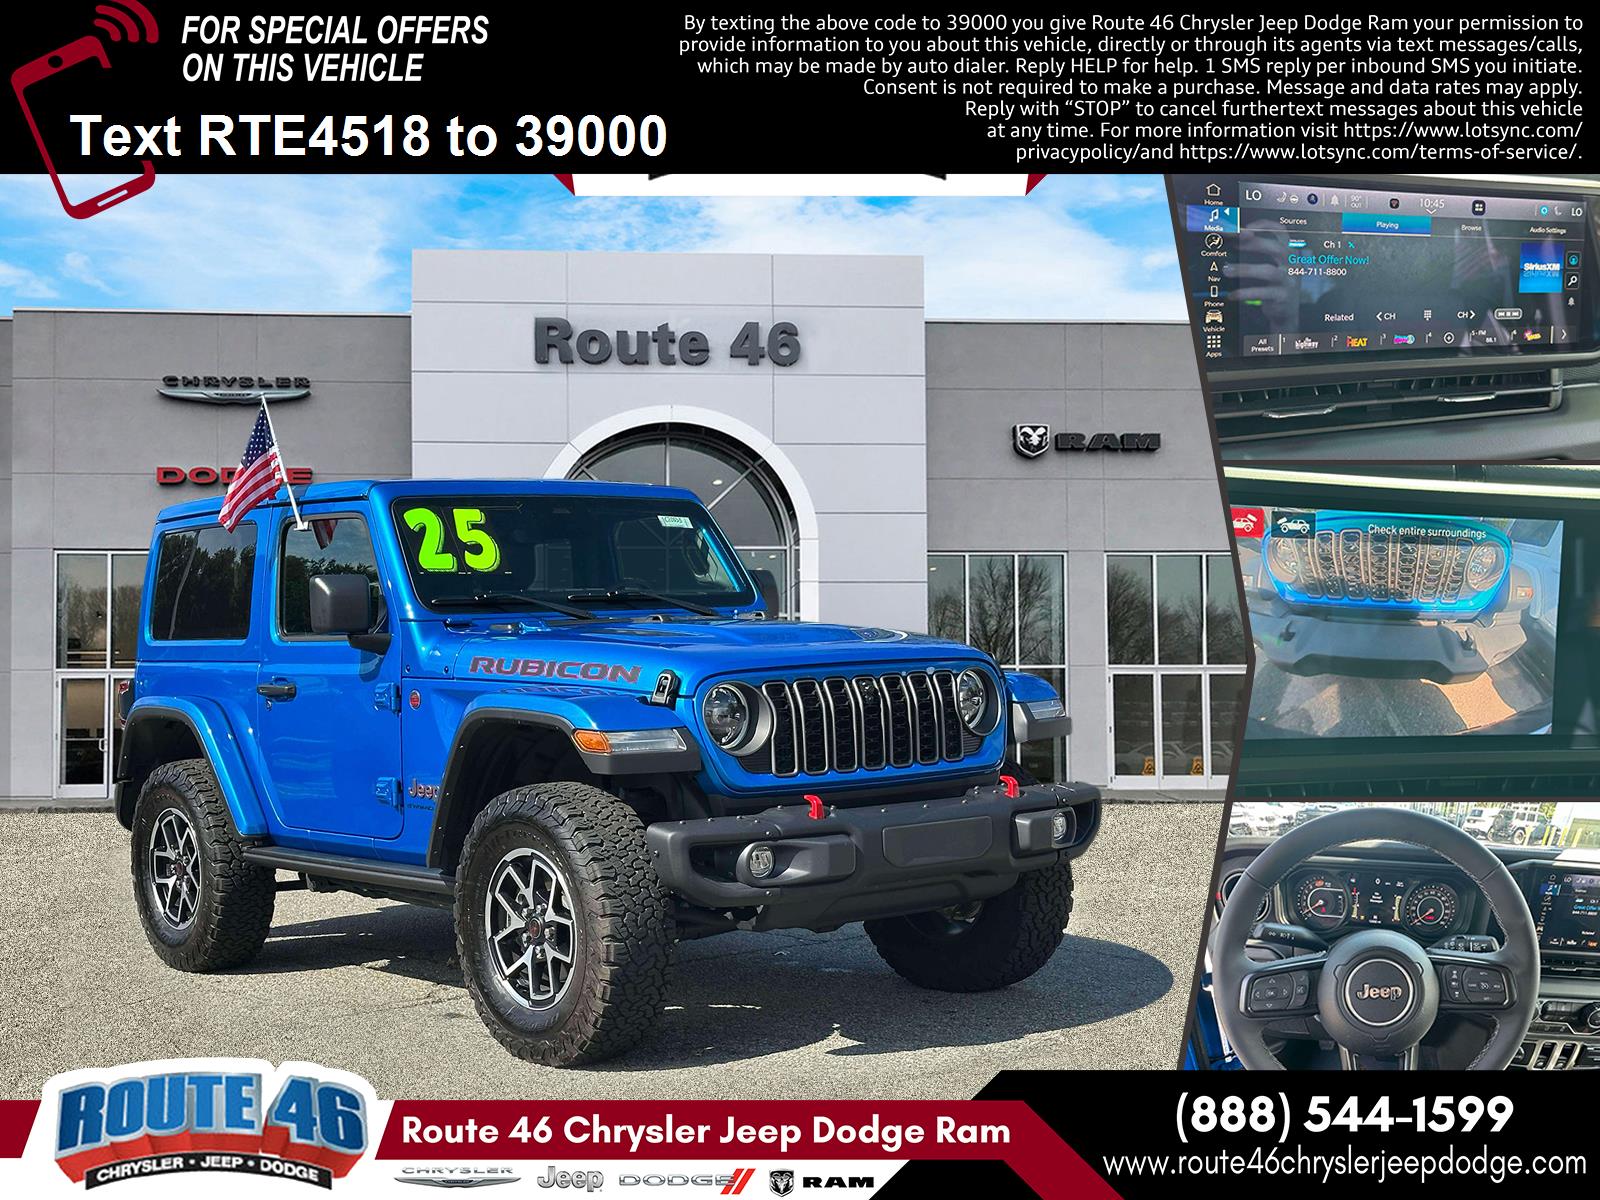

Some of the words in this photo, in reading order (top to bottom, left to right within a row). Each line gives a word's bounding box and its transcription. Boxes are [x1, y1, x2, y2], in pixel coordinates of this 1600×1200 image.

[1246, 190, 1262, 200] LO
[1420, 198, 1445, 209] 10:45
[1571, 207, 1583, 216] LO
[1279, 216, 1308, 226] Sources
[1376, 221, 1399, 230] Playing
[1461, 224, 1482, 232] Browse
[1529, 226, 1545, 234] Audio
[1545, 227, 1567, 235] Settings
[1323, 240, 1336, 248] Ch
[1288, 255, 1317, 264] Great
[1318, 255, 1343, 265] Offer
[1345, 256, 1370, 265] Now!
[1523, 262, 1560, 271] SiriusXM
[1288, 268, 1347, 276] 844-711-8800
[1324, 313, 1354, 321] Related
[1384, 312, 1396, 320] CH
[1457, 311, 1468, 319] CH
[534, 317, 711, 366] Route
[729, 321, 801, 367] 46
[1346, 338, 1368, 347] HEAT
[1251, 345, 1274, 353] Presets
[162, 375, 311, 389] CHRYSLER
[1055, 433, 1161, 451] RAM
[156, 467, 313, 485] DOE
[1368, 523, 1397, 536] Check
[1399, 526, 1425, 536] entire
[1427, 526, 1486, 539] surroundings
[403, 507, 501, 572] 25
[469, 656, 641, 684] RUBICON
[1356, 983, 1402, 1001] Jeep
